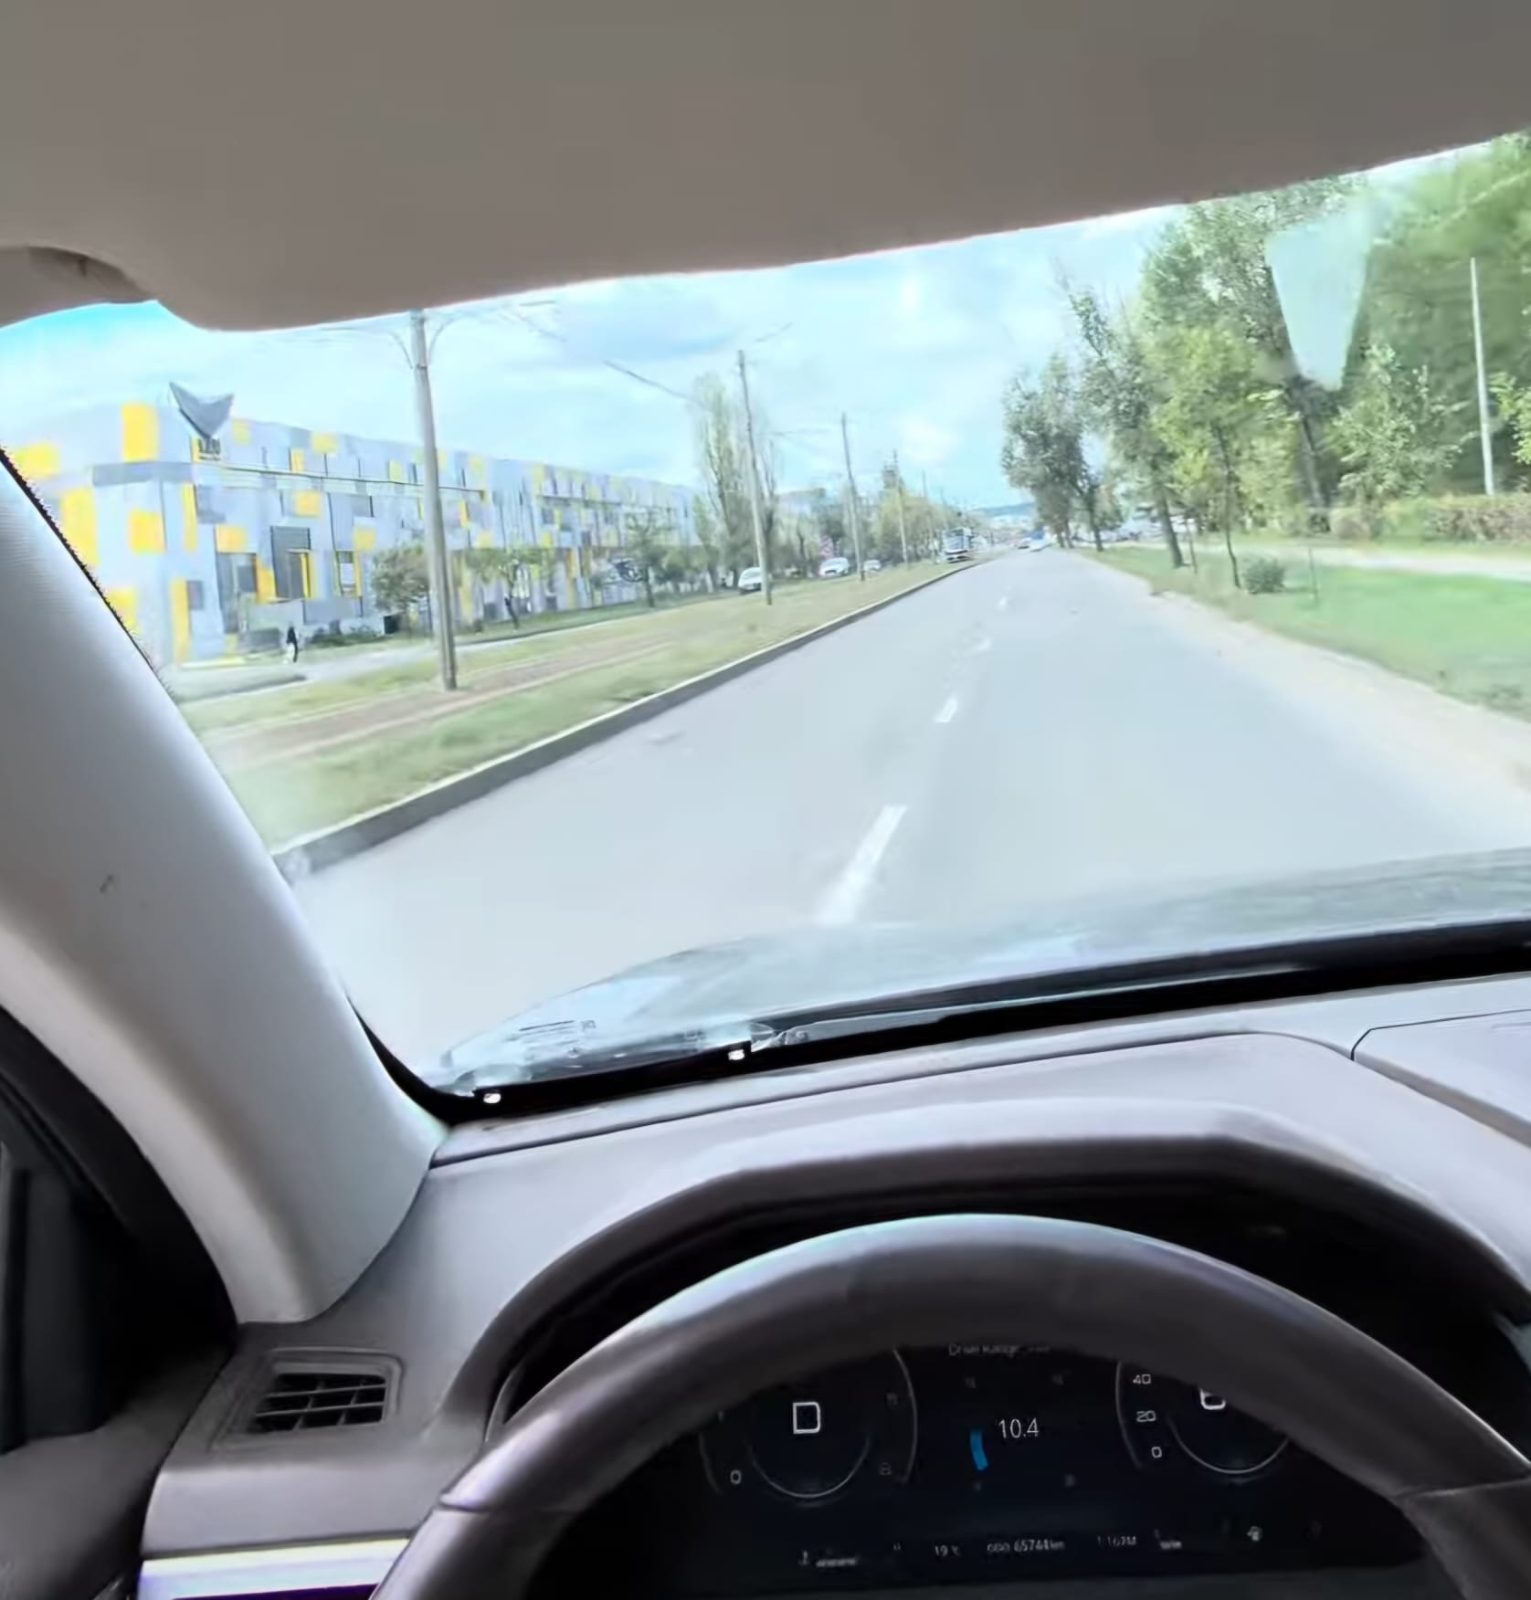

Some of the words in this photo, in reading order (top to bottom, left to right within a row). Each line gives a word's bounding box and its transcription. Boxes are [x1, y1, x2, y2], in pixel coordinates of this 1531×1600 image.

[1133, 1374, 1151, 1385] 40
[792, 1400, 821, 1435] D
[1136, 1409, 1156, 1423] 20
[998, 1416, 1040, 1439] 10.4
[1151, 1445, 1163, 1459] 0
